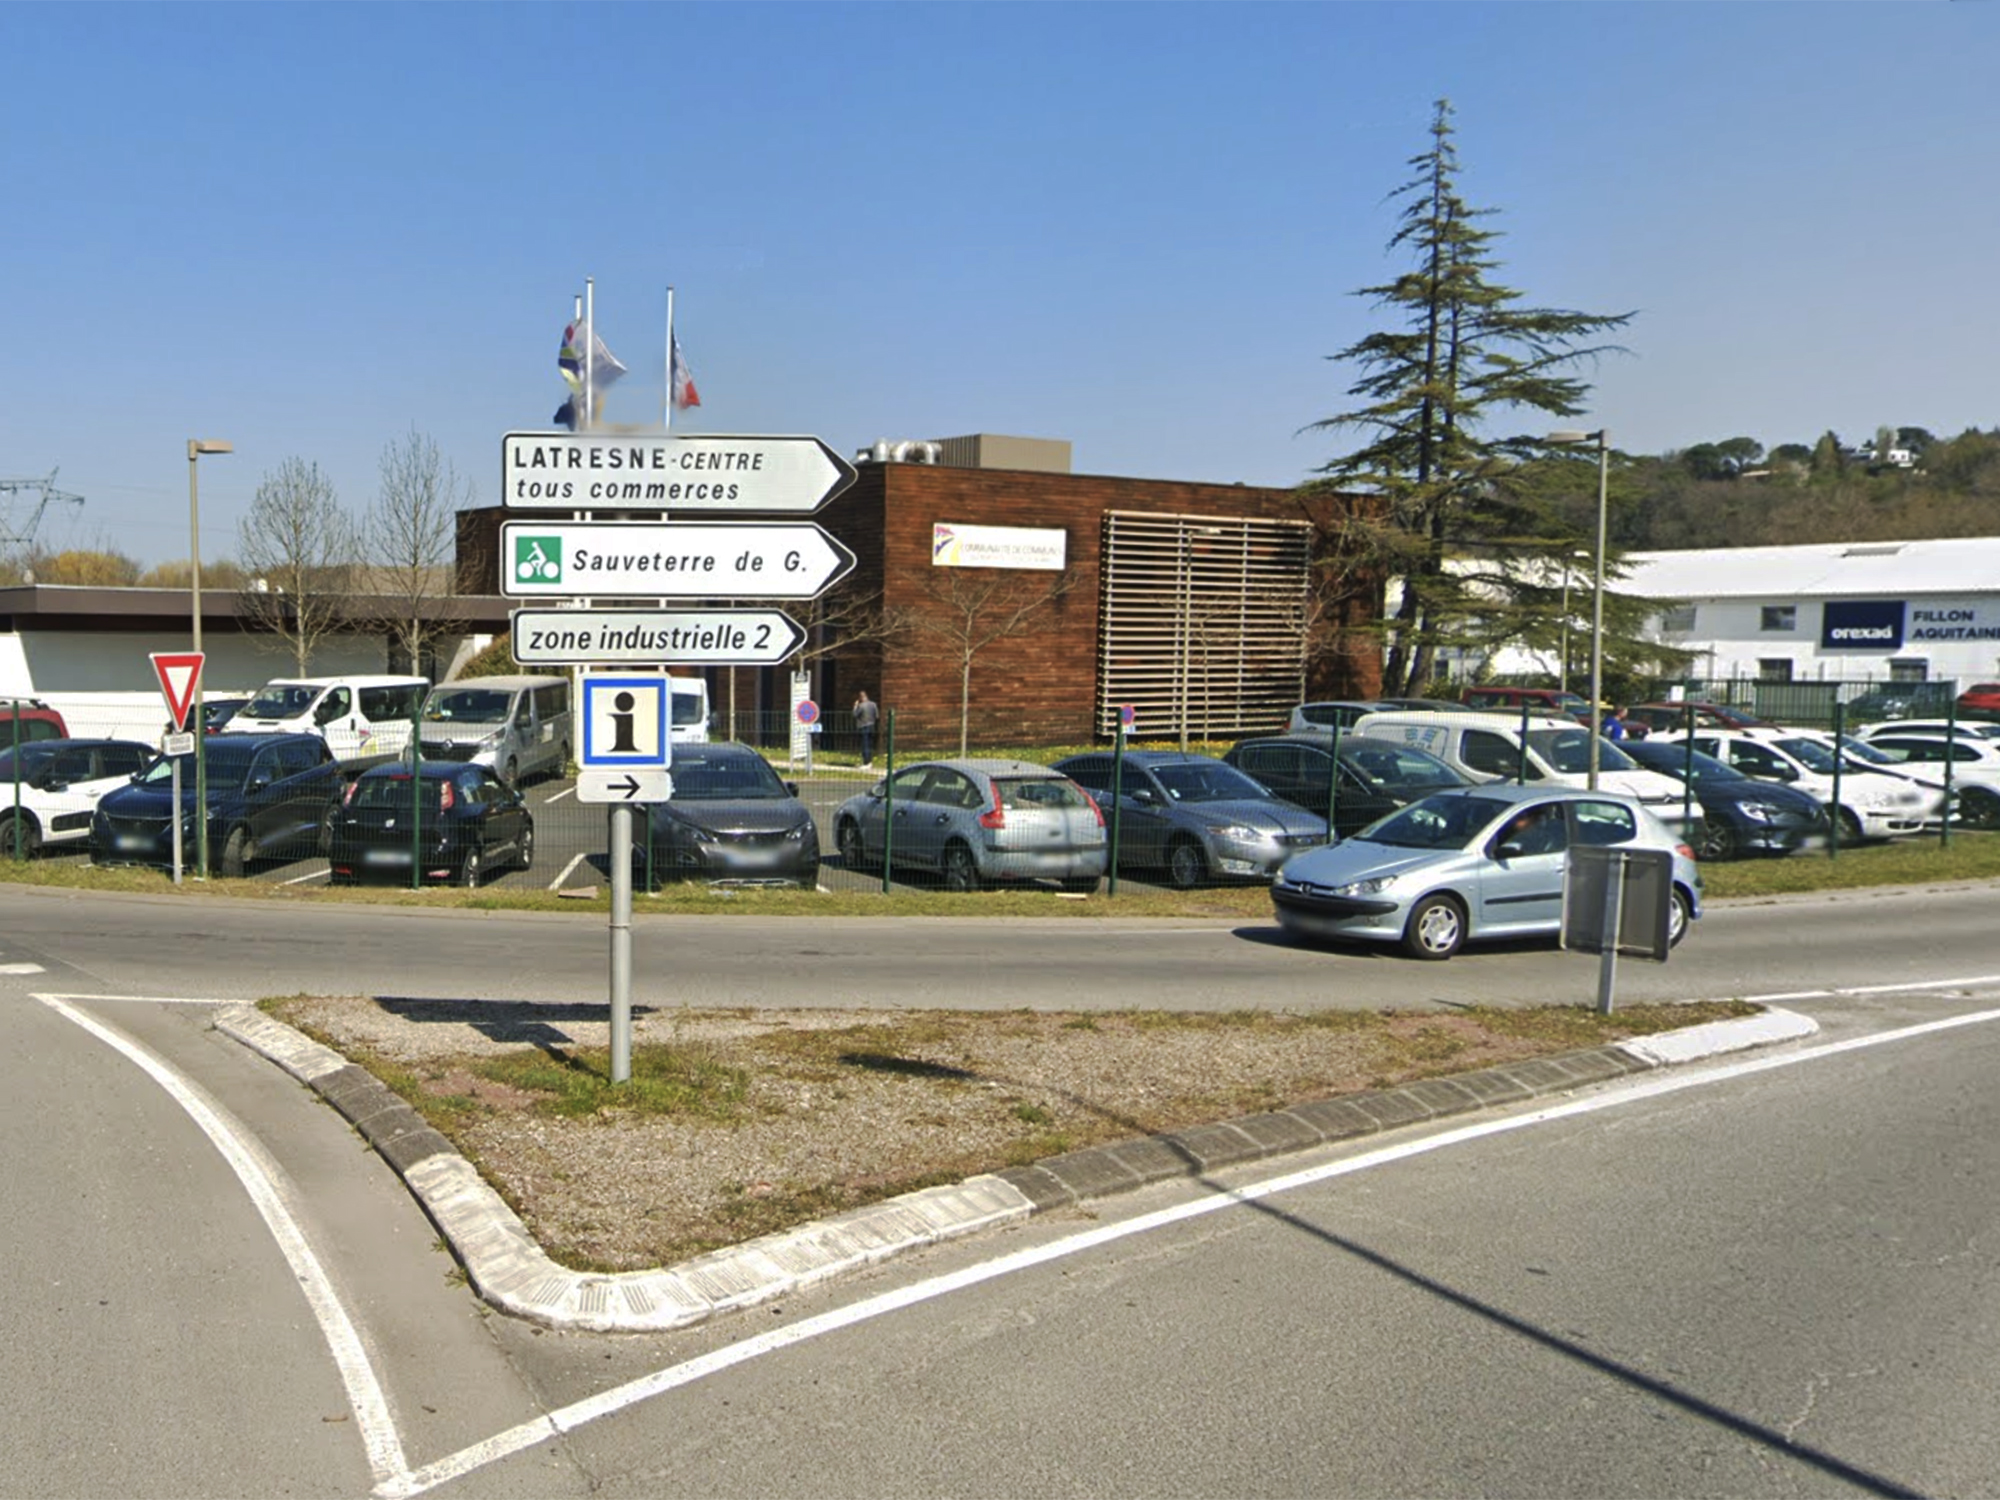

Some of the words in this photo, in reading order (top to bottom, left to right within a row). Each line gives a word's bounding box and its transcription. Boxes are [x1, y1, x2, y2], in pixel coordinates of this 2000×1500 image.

[514, 446, 764, 470] LATRESNE-CENTRE
[517, 478, 574, 498] tous
[590, 482, 739, 500] commerces
[573, 549, 715, 572] Sauveterre
[735, 550, 763, 572] de
[784, 550, 808, 573] G.
[1913, 609, 1974, 622] FILLON
[529, 629, 591, 650] zone
[600, 624, 746, 650] industrielle
[753, 624, 772, 650] 2
[1831, 624, 1893, 639] orexad
